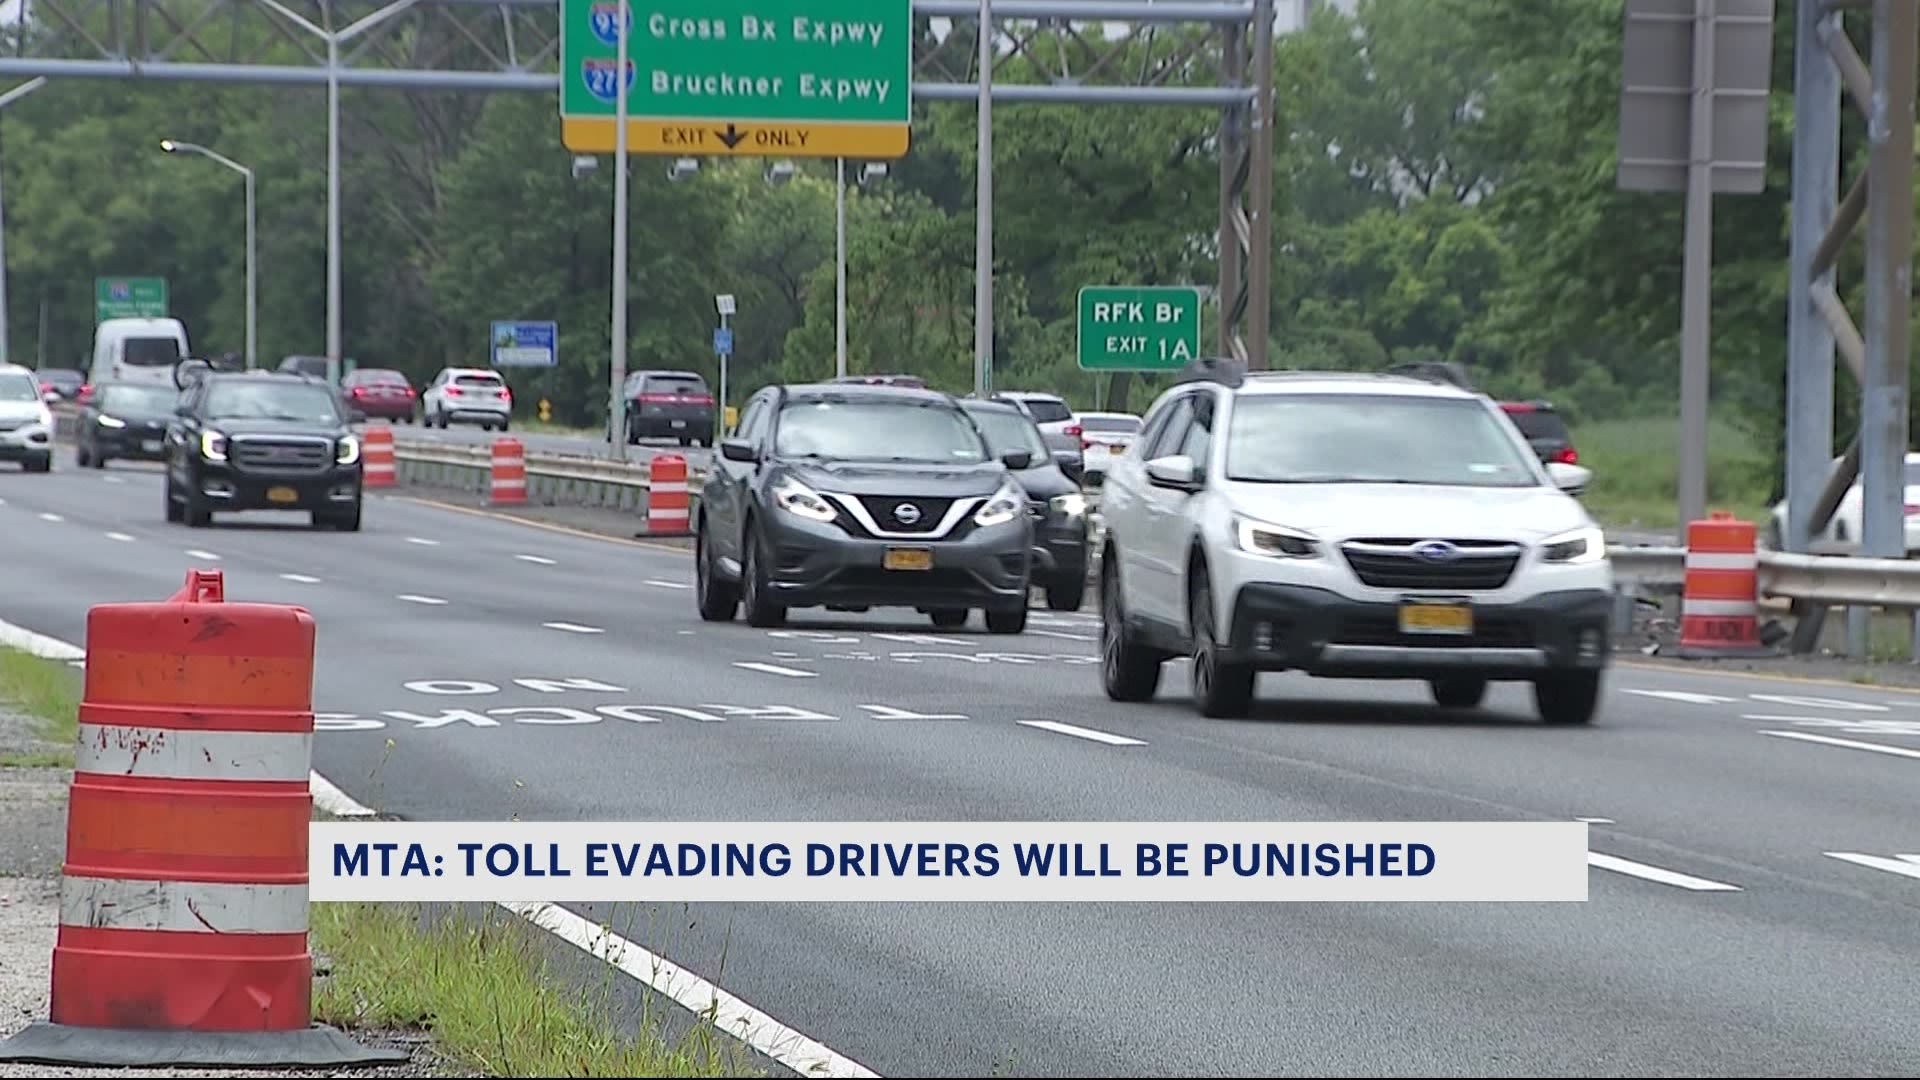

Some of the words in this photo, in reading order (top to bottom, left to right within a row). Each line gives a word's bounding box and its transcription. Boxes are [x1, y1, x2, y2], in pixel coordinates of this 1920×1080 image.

[649, 13, 727, 40] Cross
[742, 15, 776, 41] Bx
[793, 16, 883, 48] Expwy
[652, 70, 782, 96] Bruckner
[800, 73, 890, 104] Expwy
[662, 127, 705, 145] EXIT
[755, 129, 809, 147] ONLY
[1094, 302, 1144, 323] RFK
[1155, 302, 1184, 323] Br
[1106, 336, 1147, 353] EXIT
[1158, 338, 1191, 360] 1A
